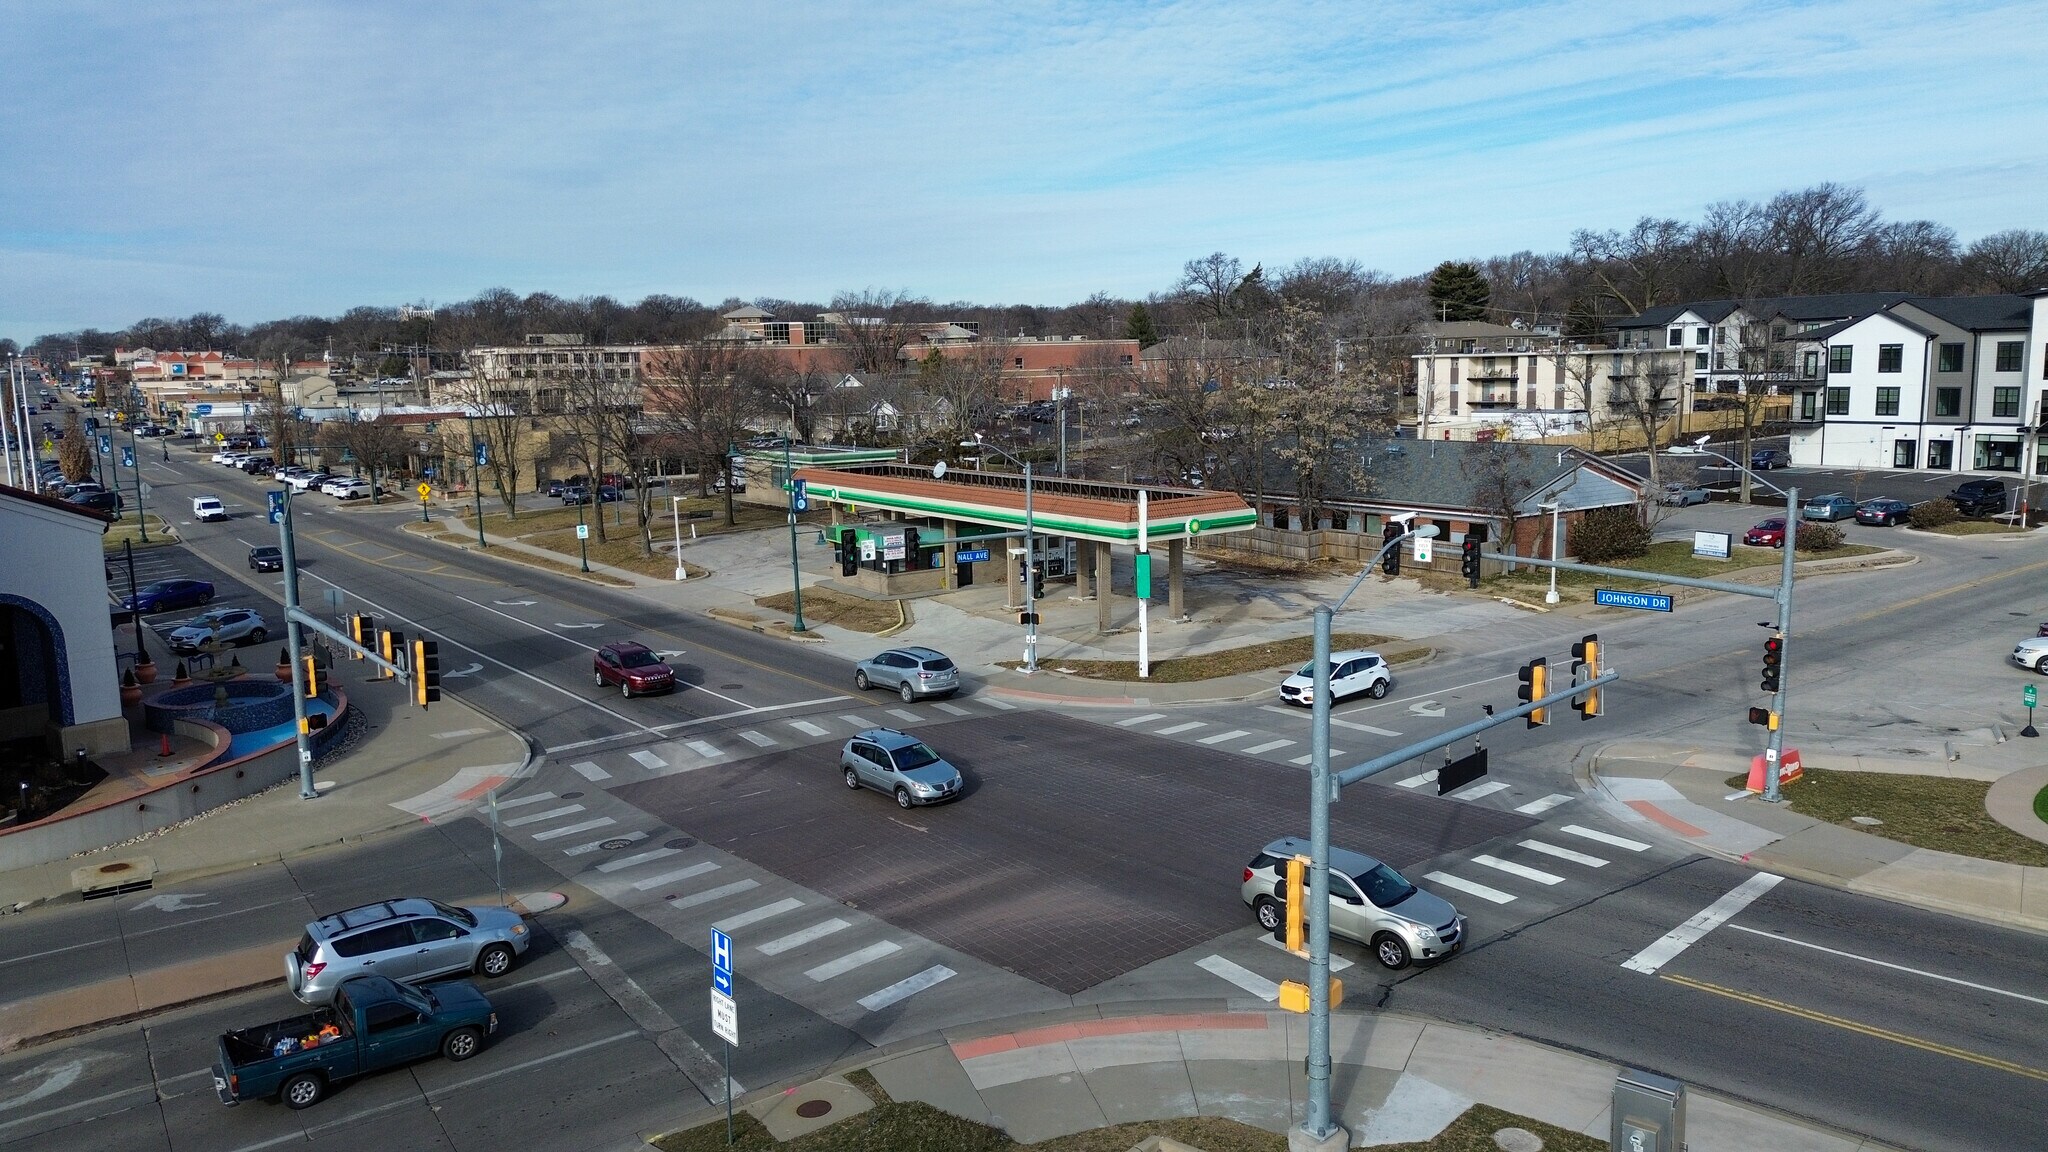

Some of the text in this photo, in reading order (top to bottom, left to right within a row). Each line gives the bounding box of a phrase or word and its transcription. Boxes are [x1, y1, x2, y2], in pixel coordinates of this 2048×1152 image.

[958, 551, 987, 560] NALL AVE
[1600, 593, 1666, 608] JOHNSON DR
[715, 932, 730, 970] H
[724, 1001, 734, 1013] LANE
[717, 1008, 731, 1024] MUST
[713, 1019, 736, 1040] TURN RIGHT
